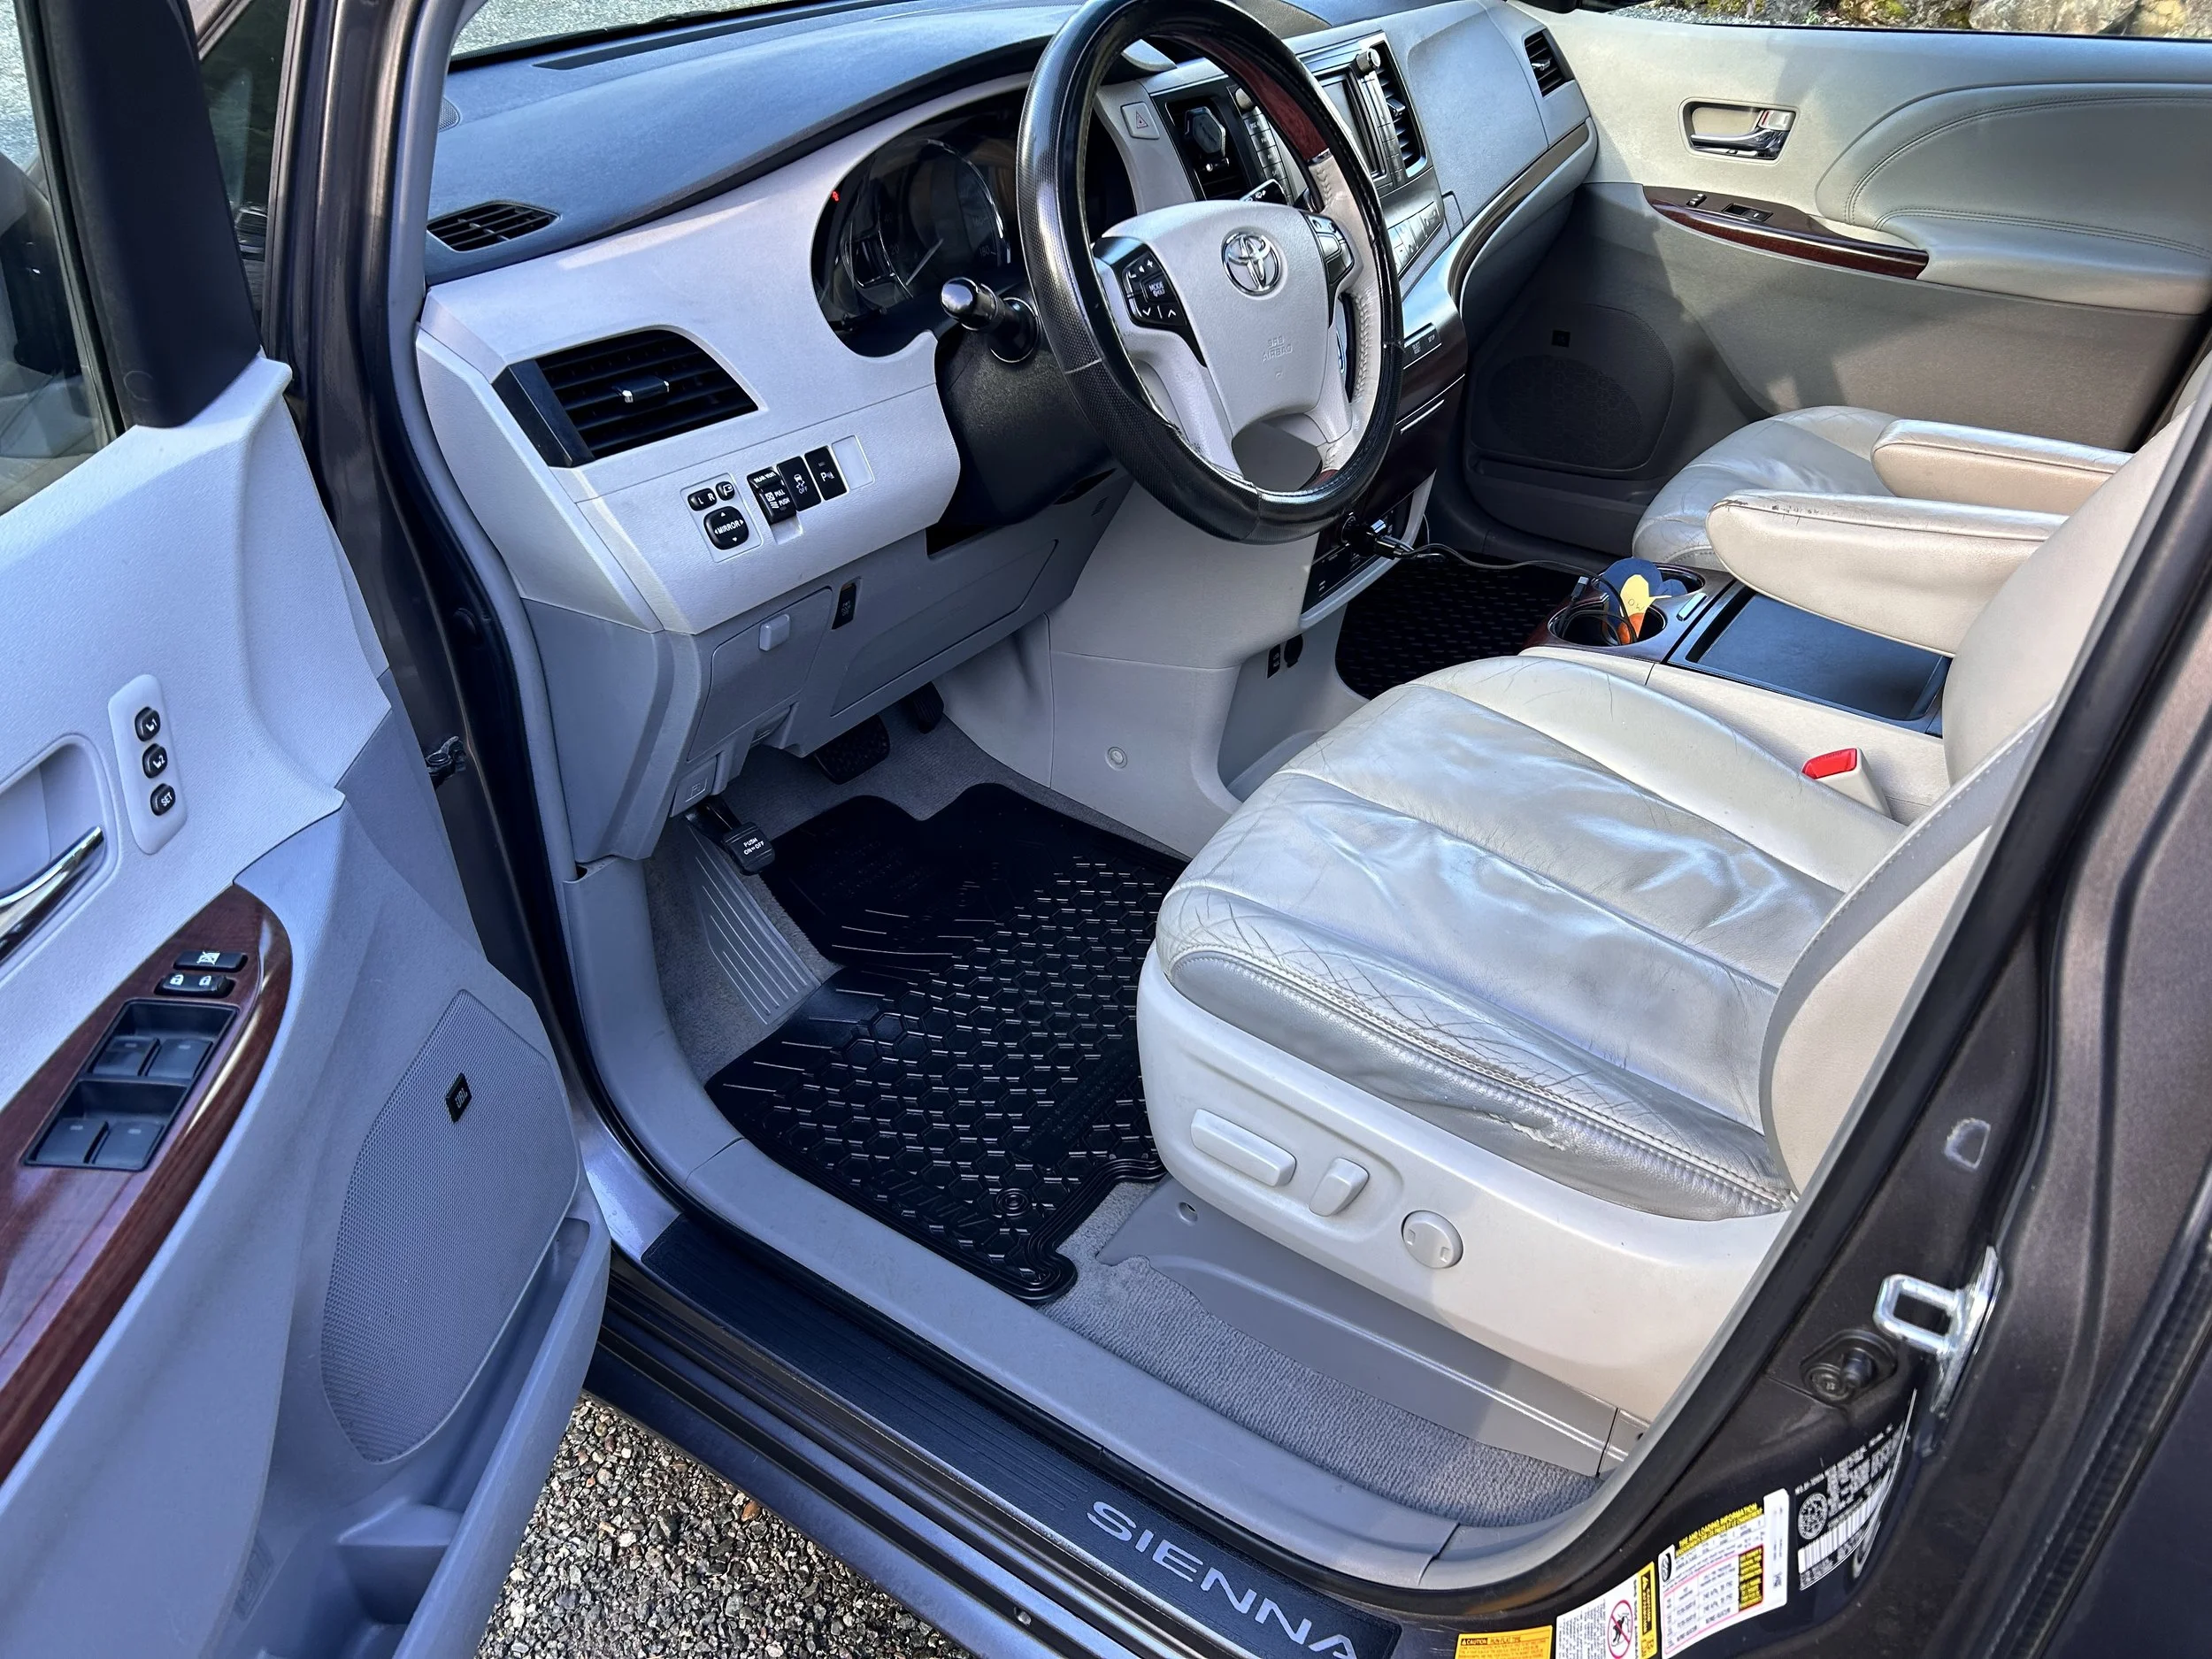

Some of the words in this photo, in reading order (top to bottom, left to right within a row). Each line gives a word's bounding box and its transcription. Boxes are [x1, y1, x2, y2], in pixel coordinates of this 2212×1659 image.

[707, 493, 715, 502] R
[774, 488, 786, 497] PULL
[778, 496, 791, 506] PUSH
[717, 520, 741, 534] MIRROR
[159, 755, 165, 765] 2
[161, 792, 173, 807] SET
[743, 837, 758, 848] PUSH
[455, 1087, 468, 1109] JBL
[1087, 1502, 1356, 1659] SIENNA
